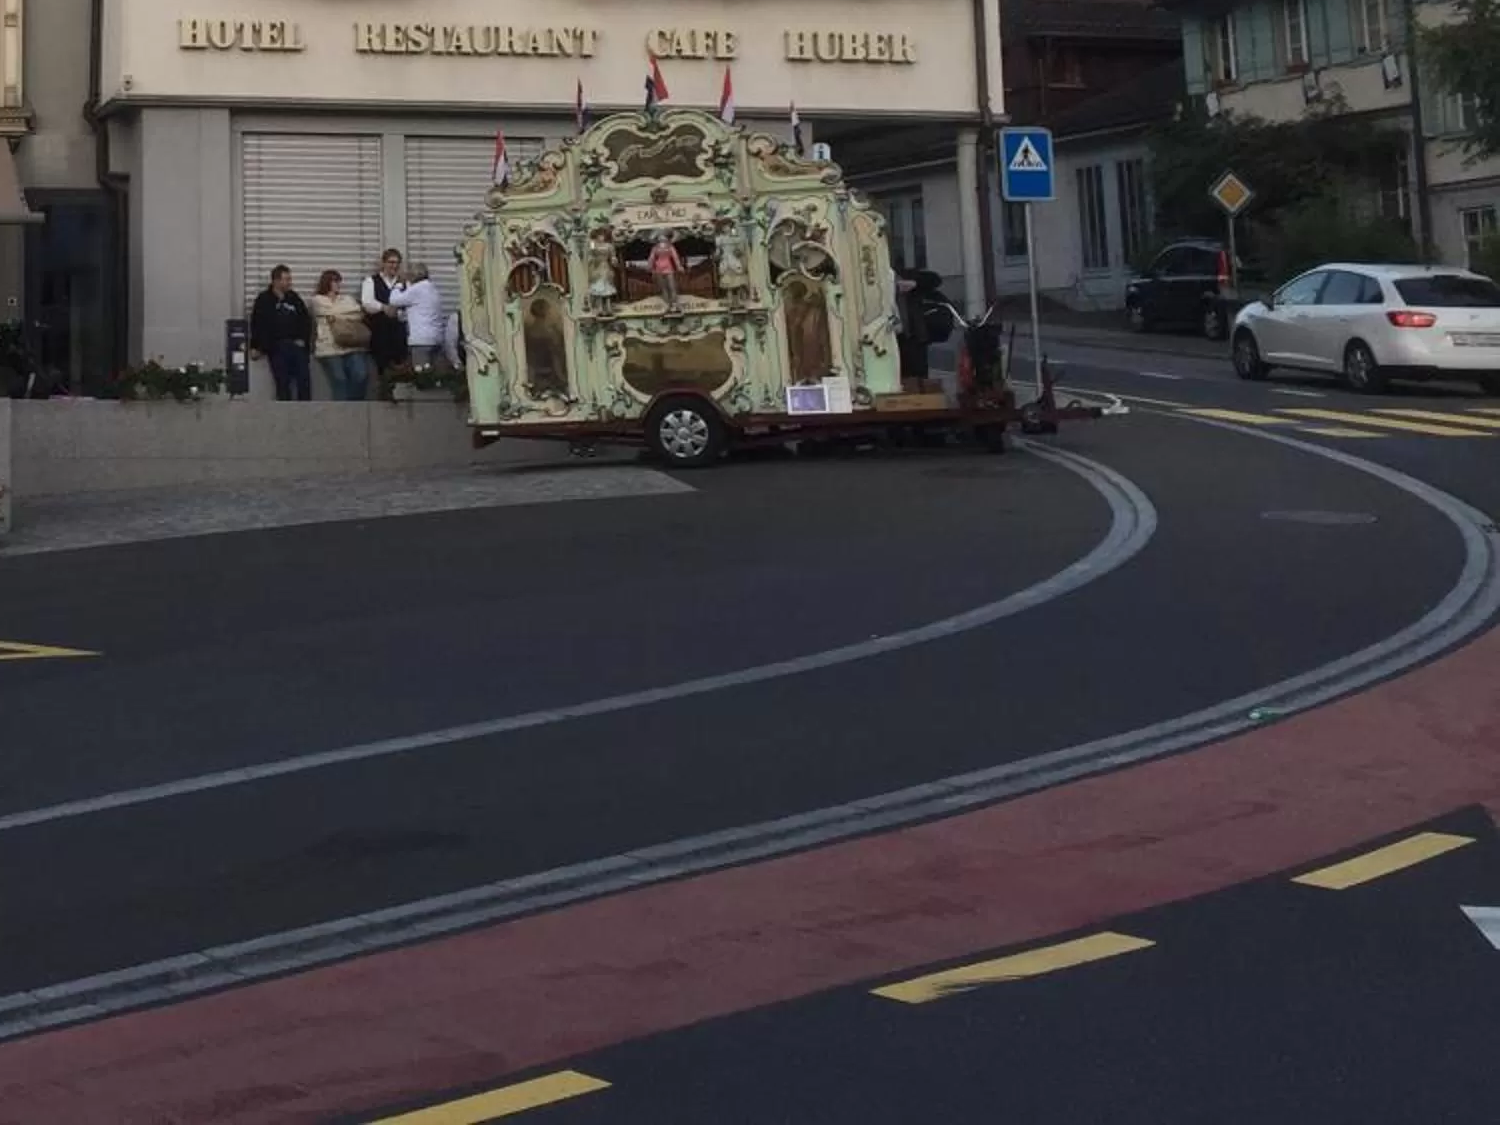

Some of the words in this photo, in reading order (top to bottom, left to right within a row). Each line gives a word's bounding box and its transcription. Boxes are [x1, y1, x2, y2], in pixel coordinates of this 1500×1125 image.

[179, 18, 305, 51] HOTEL
[354, 22, 597, 58] RESTAURANT
[648, 26, 737, 60] CAFE
[784, 29, 916, 63] HUBER
